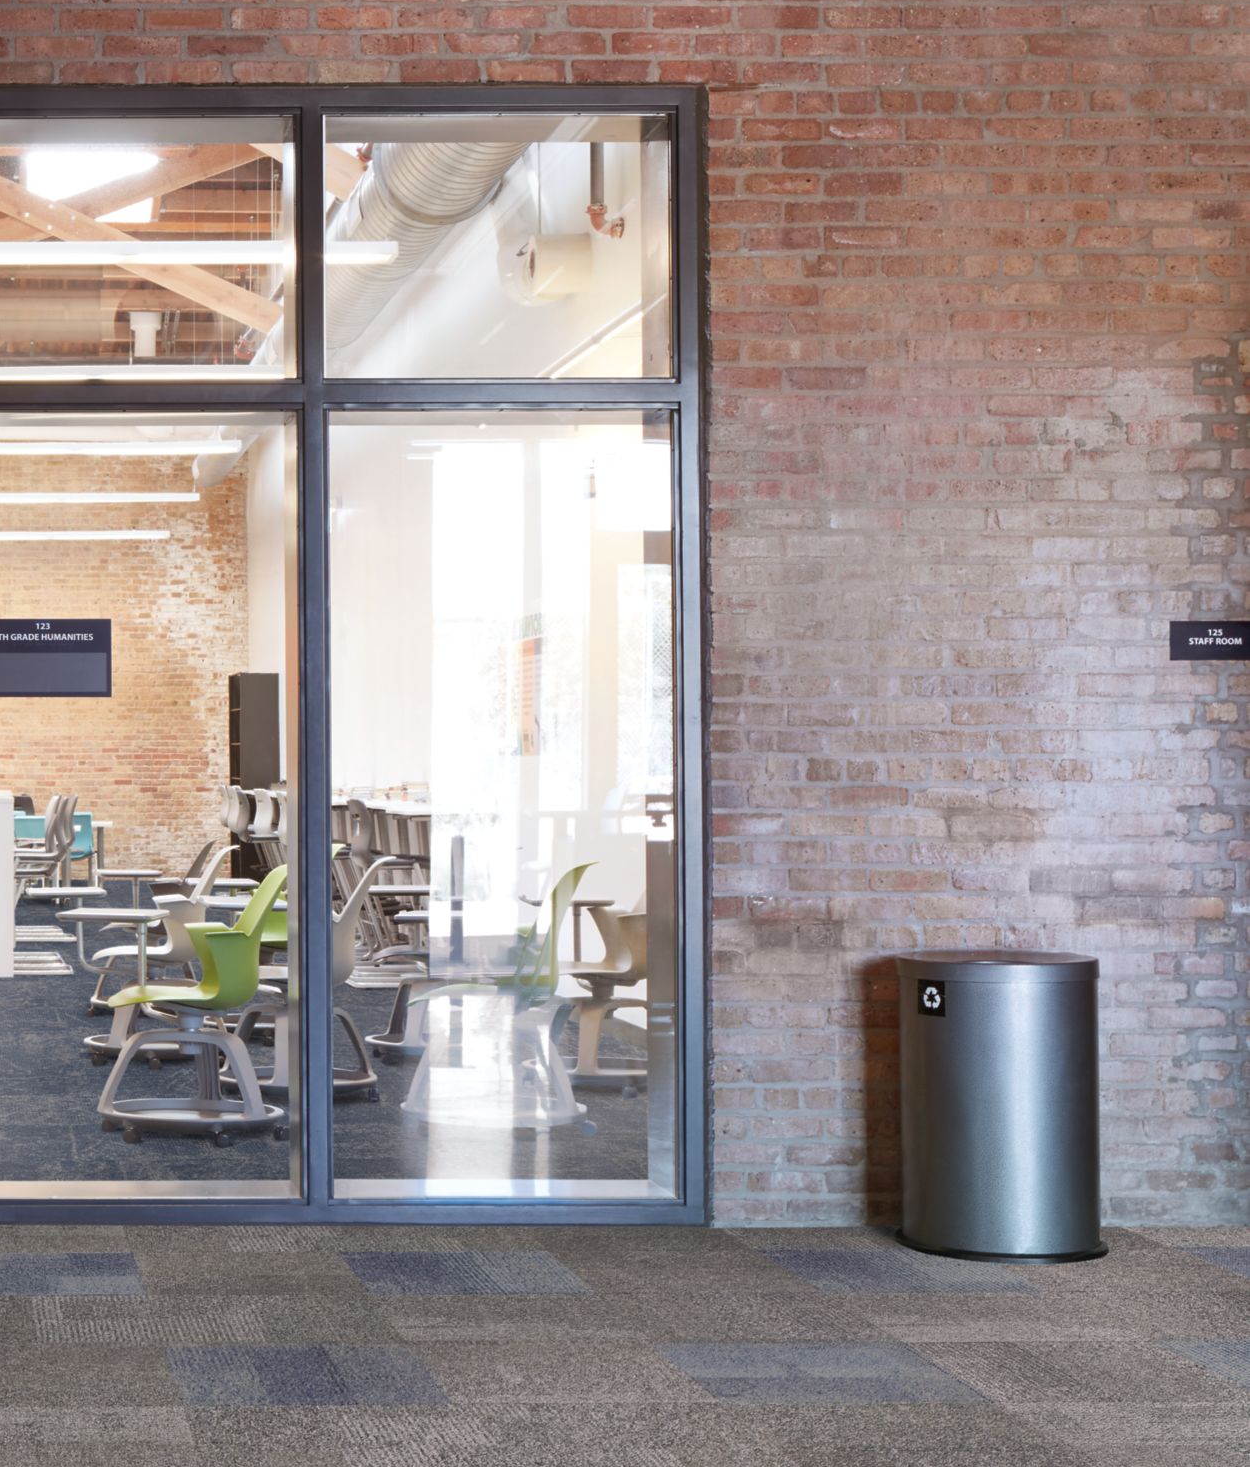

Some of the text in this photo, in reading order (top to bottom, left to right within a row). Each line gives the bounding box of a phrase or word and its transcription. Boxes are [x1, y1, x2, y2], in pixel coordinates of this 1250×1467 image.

[10, 633, 39, 641] GRADE
[41, 633, 94, 641] HUMANITIES
[1189, 637, 1242, 645] STAFF ROOM
